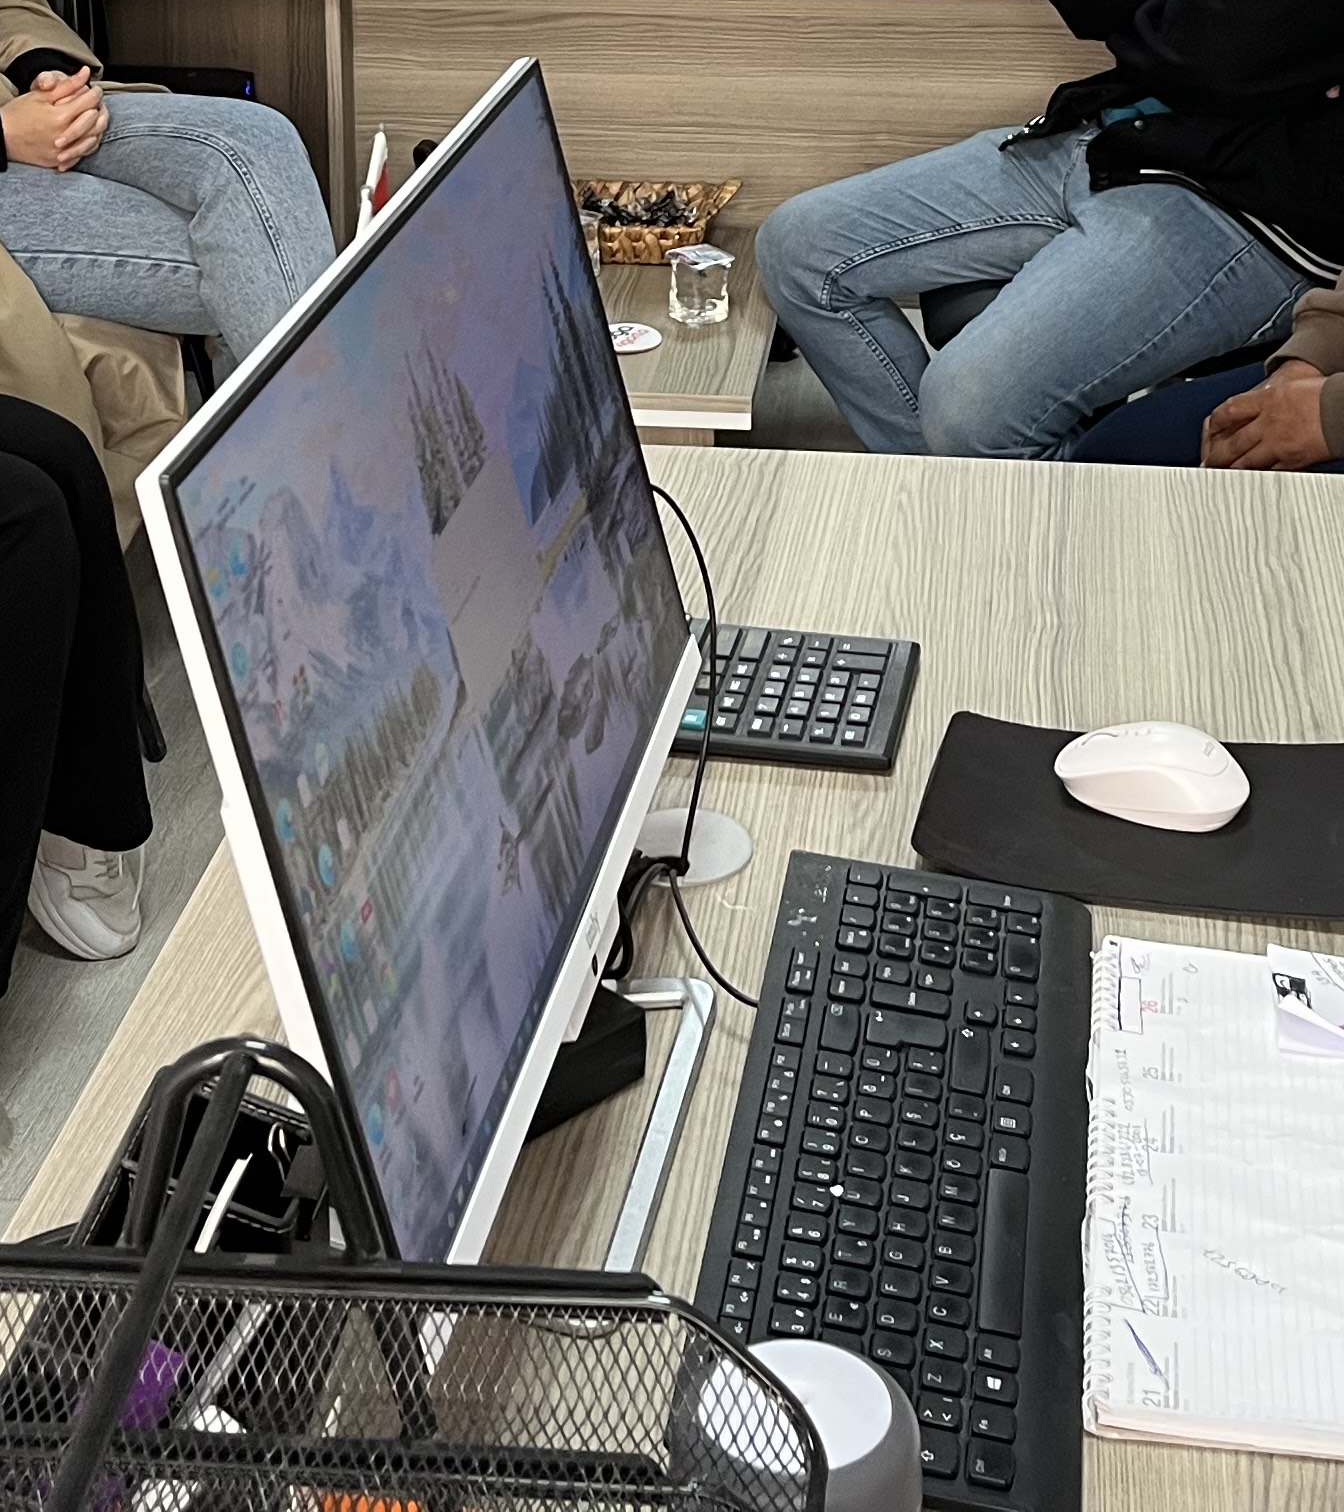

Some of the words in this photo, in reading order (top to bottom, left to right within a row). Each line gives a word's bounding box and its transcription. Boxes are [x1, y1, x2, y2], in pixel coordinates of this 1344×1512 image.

[1141, 1213, 1159, 1230] 23
[1142, 1299, 1160, 1317] 22
[1142, 1389, 1161, 1408] 21
